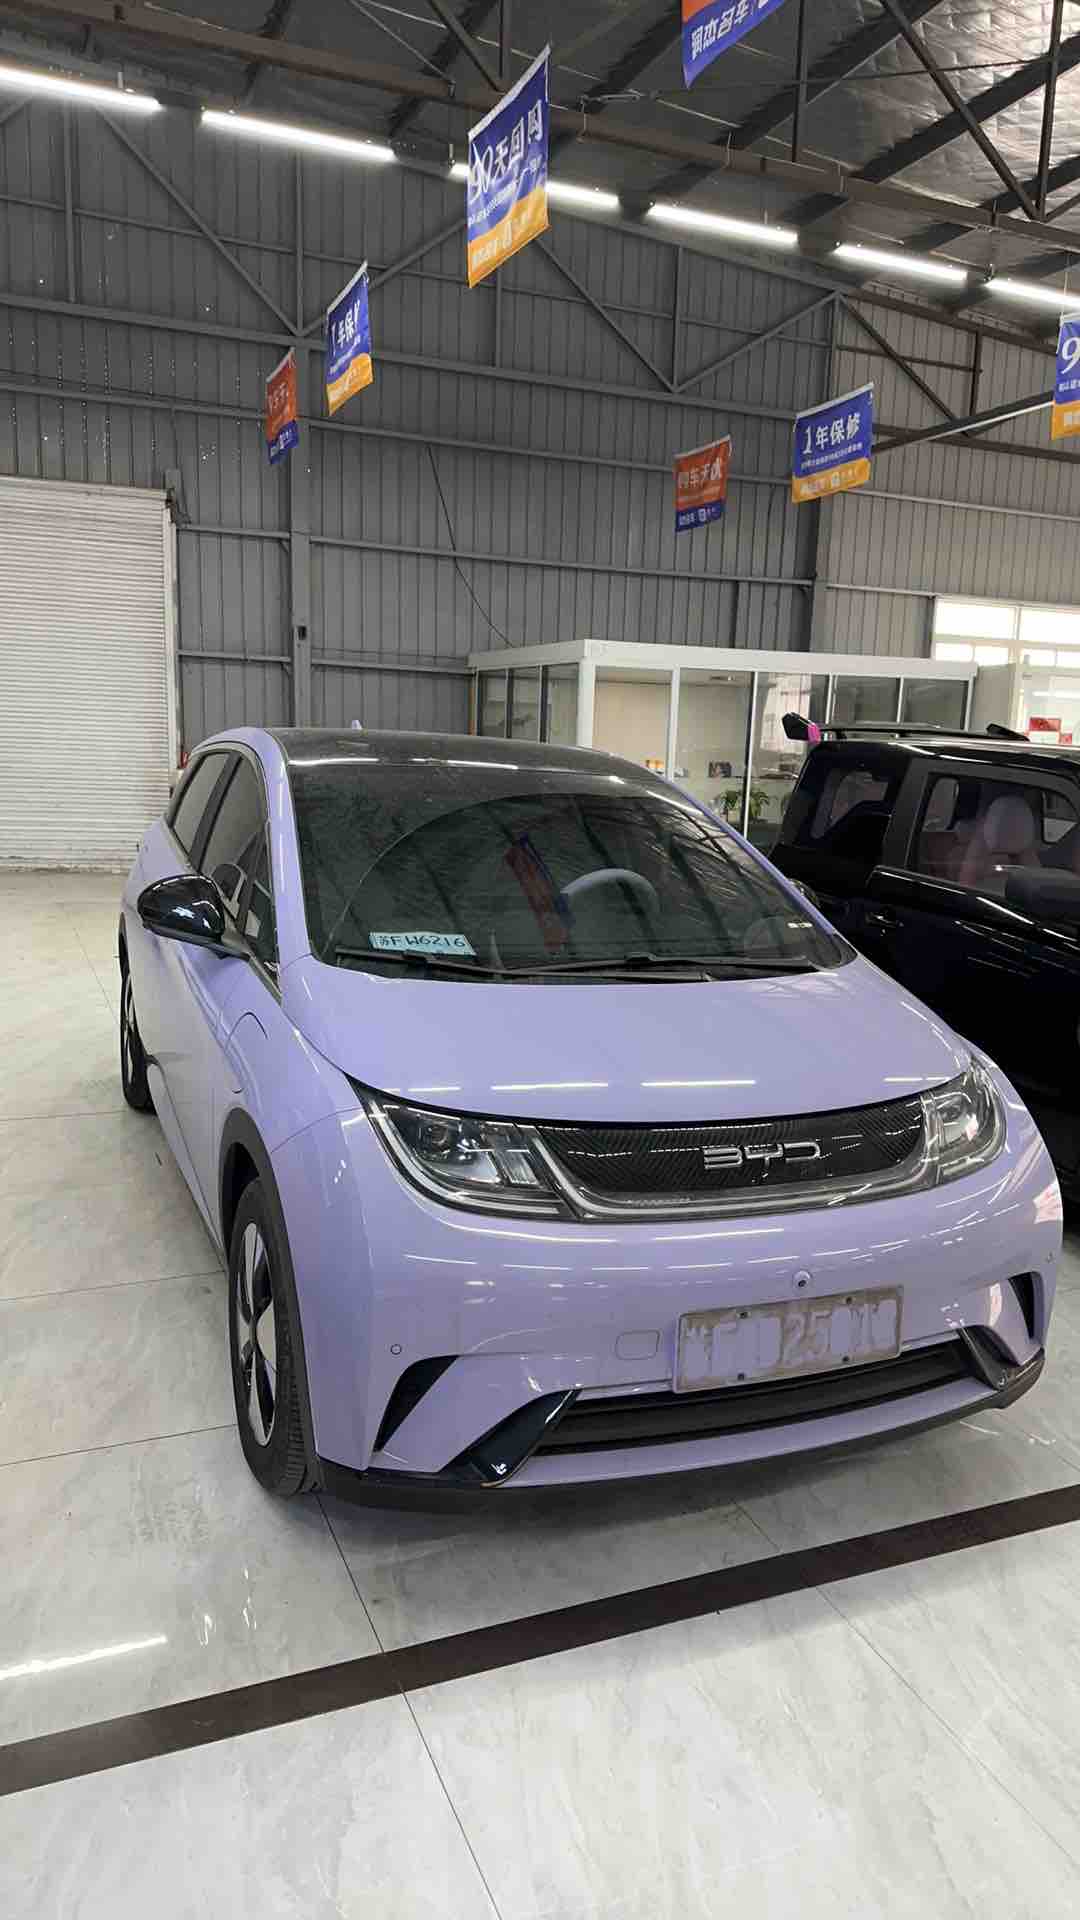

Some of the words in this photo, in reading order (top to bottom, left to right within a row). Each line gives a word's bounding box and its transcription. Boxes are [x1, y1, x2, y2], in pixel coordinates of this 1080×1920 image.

[802, 412, 861, 454] 1年保修
[703, 1141, 821, 1170] BYD
